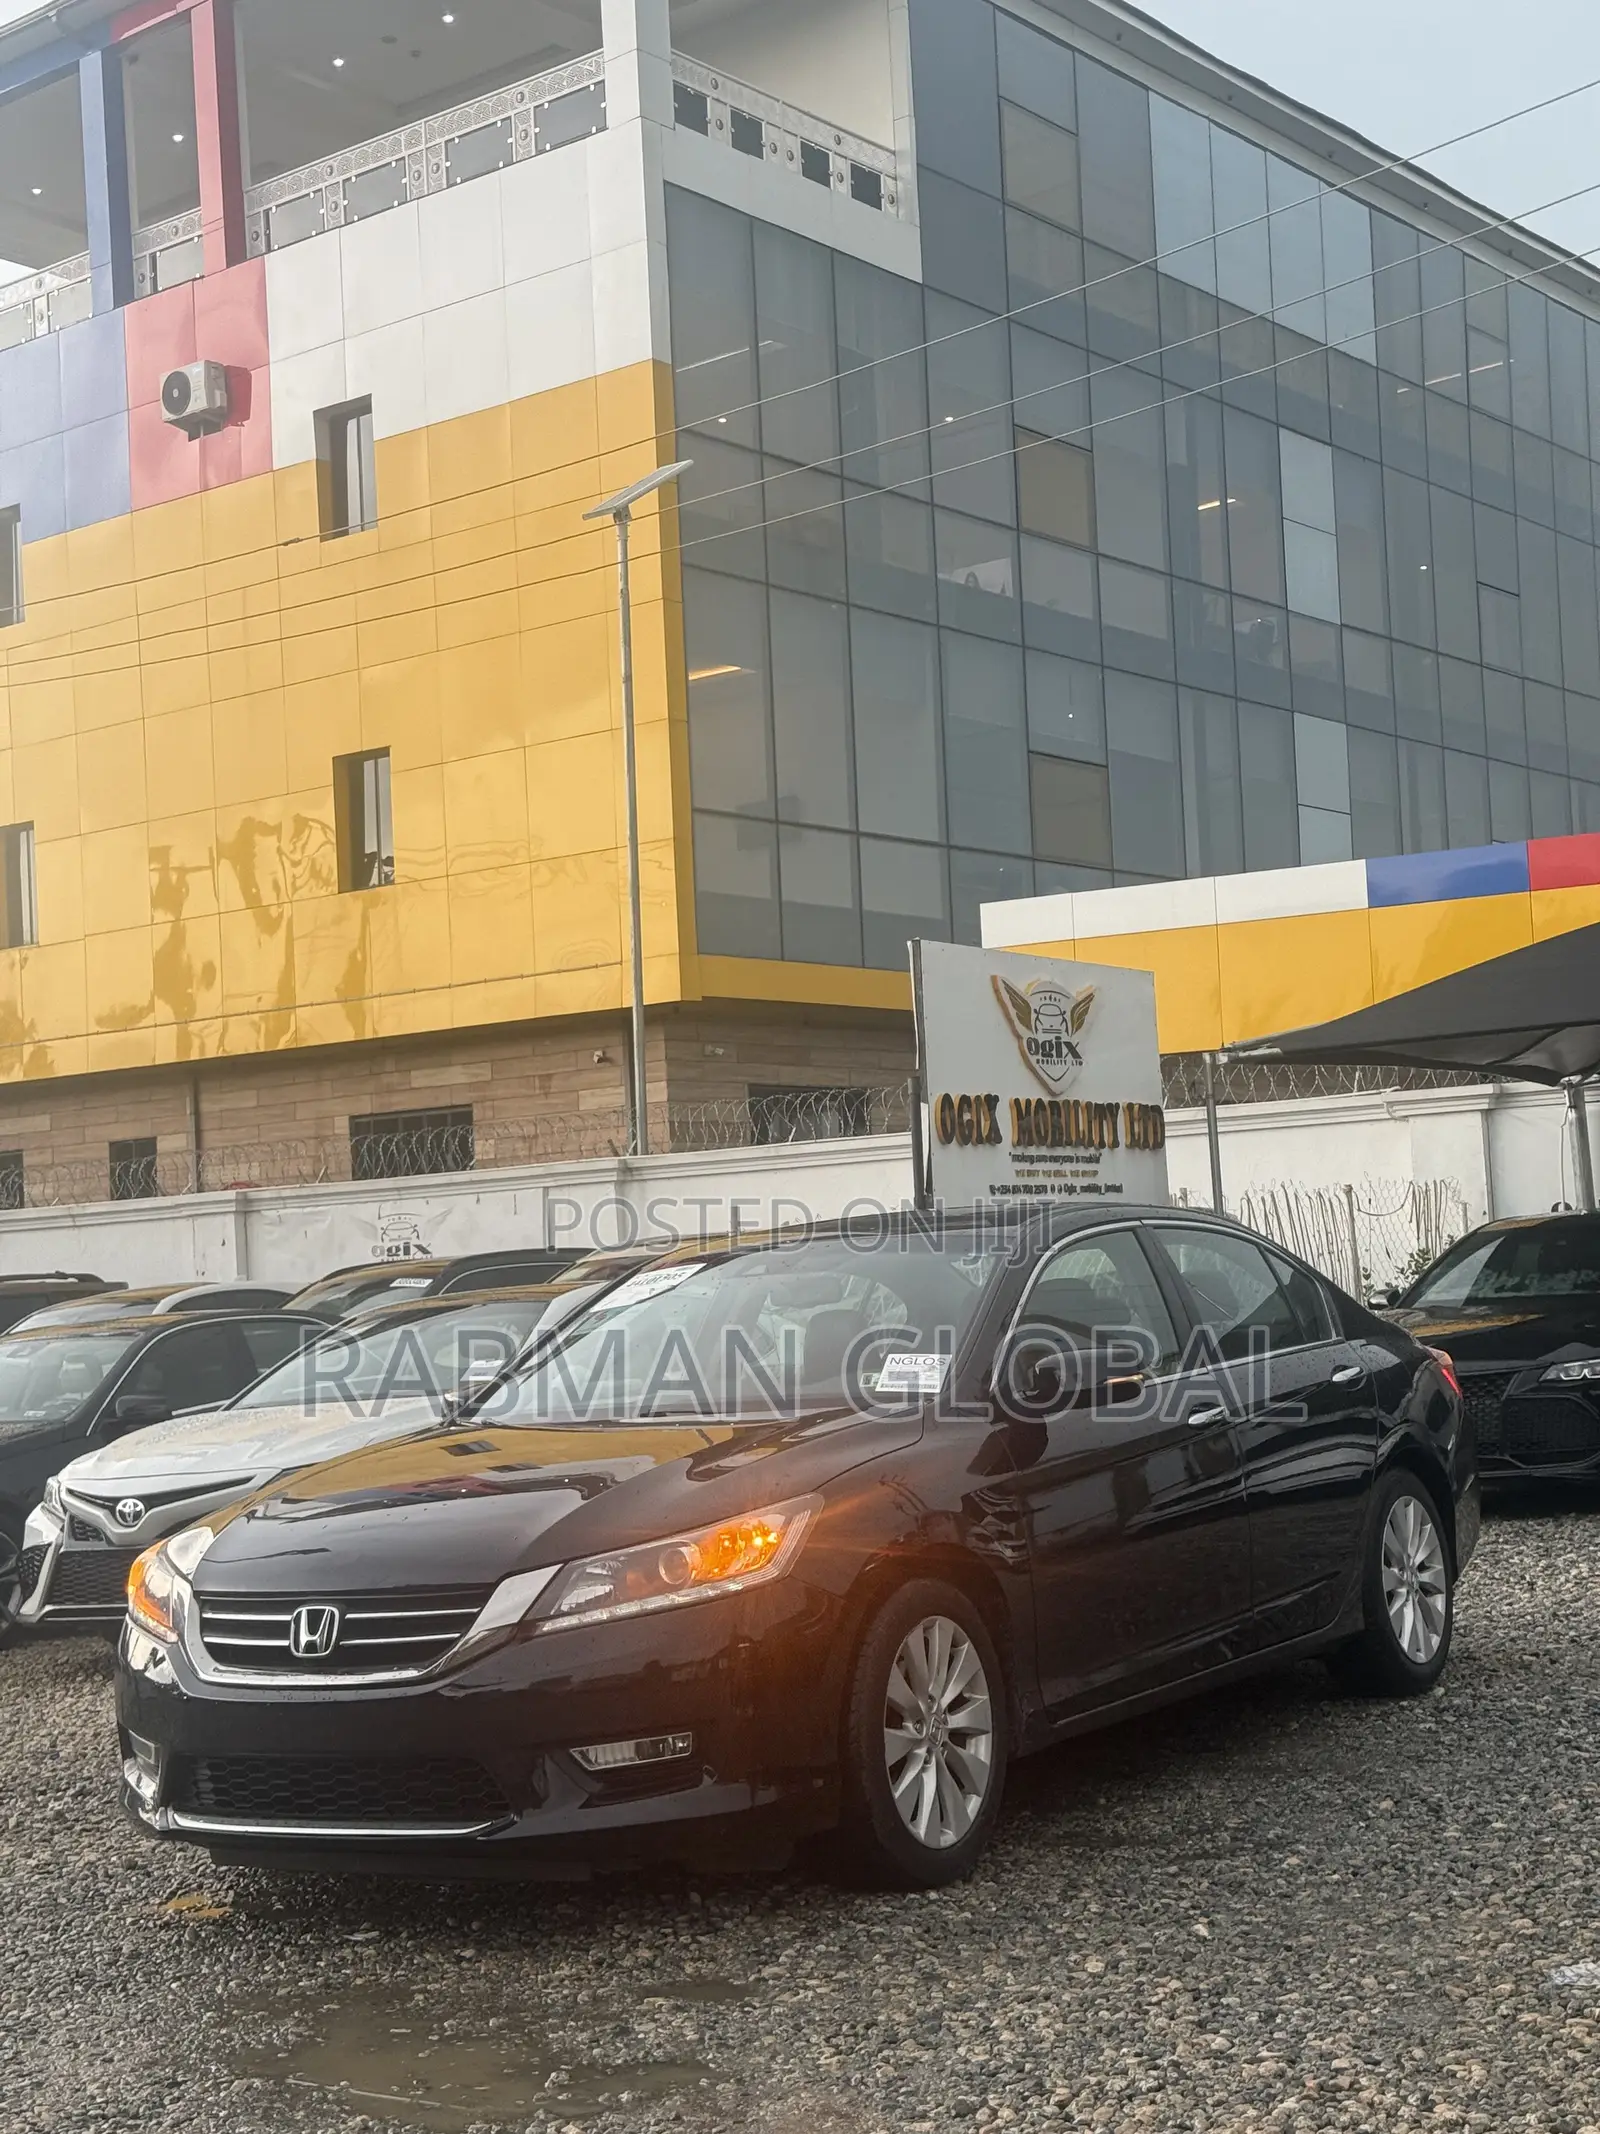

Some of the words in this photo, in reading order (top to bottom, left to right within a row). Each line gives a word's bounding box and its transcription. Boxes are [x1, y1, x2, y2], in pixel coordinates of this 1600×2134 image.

[935, 1092, 1003, 1146] OGIX
[1009, 1097, 1120, 1150] MOBILITY
[1122, 1101, 1165, 1150] LTD
[889, 1356, 947, 1366] NGLOS
